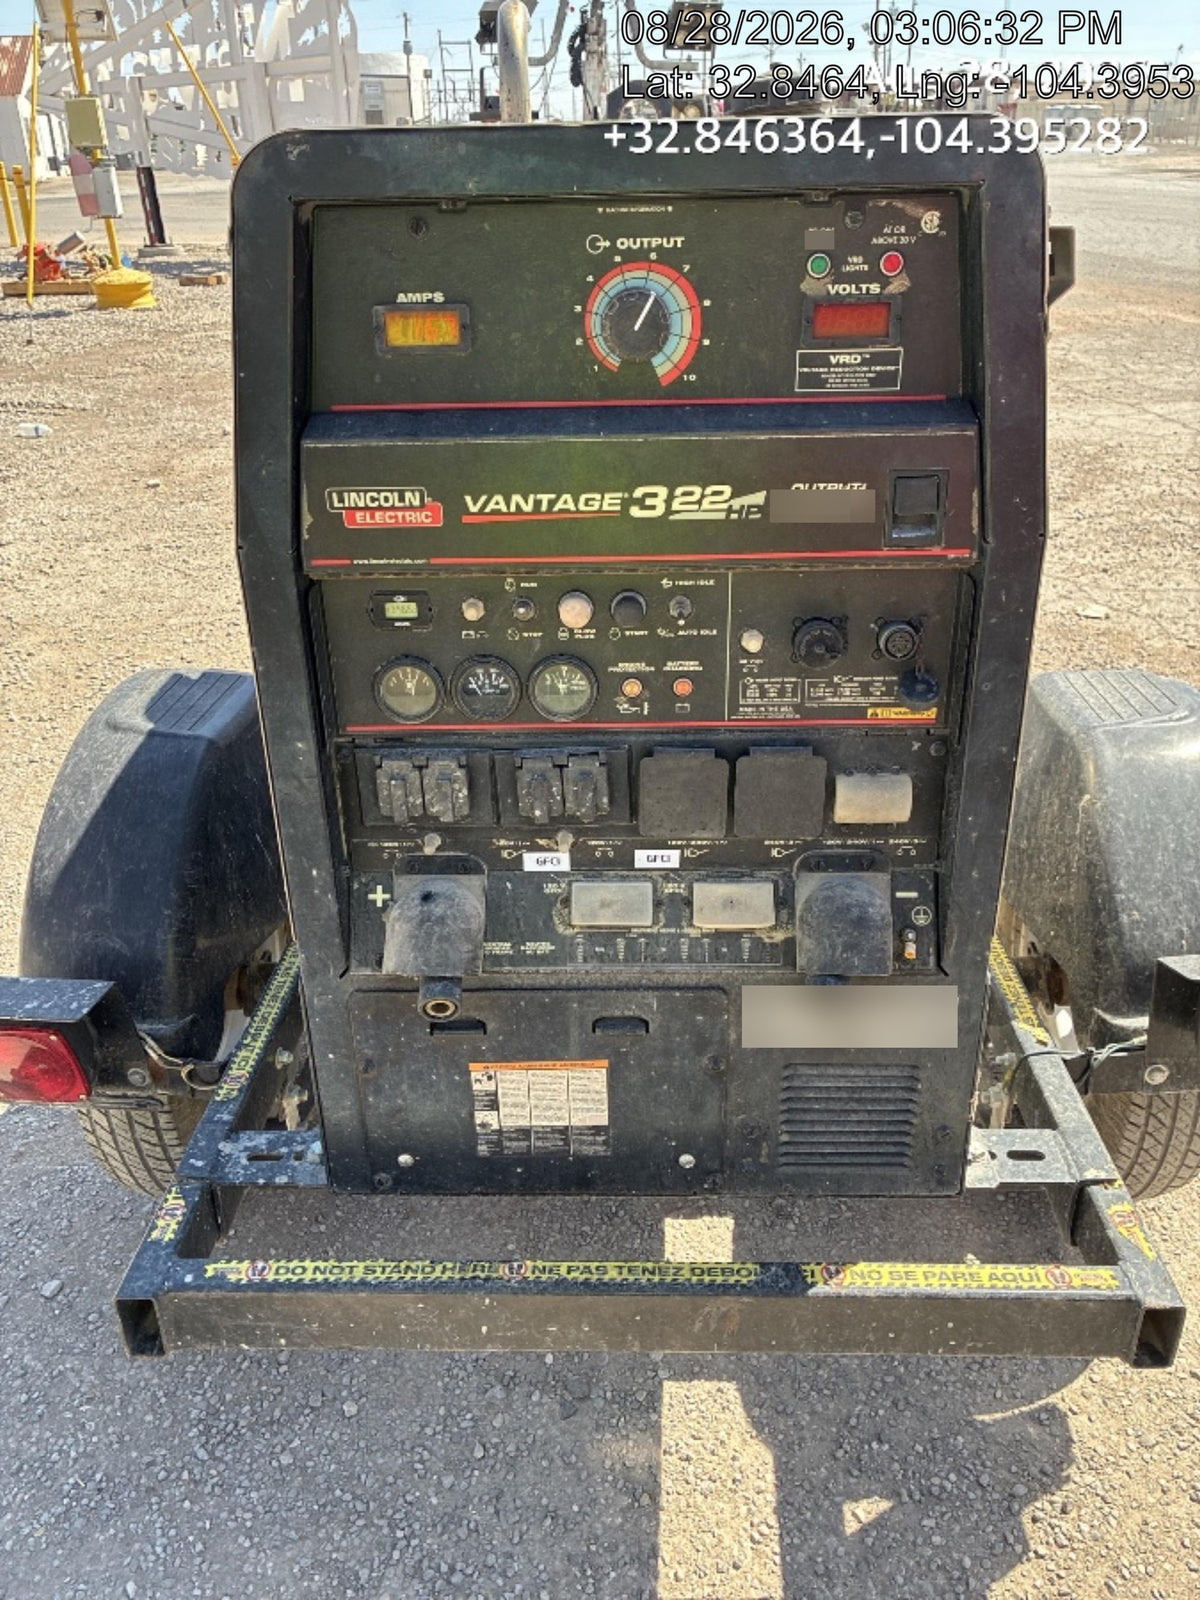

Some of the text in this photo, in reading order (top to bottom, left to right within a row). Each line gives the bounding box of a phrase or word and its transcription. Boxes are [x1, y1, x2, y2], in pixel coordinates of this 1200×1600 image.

[616, 237, 685, 250] OUTPUT
[683, 265, 691, 273] 7
[842, 264, 869, 273] LIGHTS
[827, 283, 881, 295] VOLTS
[396, 291, 445, 304] AMPS
[575, 338, 583, 346] 2
[593, 365, 599, 373] 1
[682, 374, 697, 382] 10
[332, 491, 421, 508] LINCOLN
[628, 484, 732, 519] 322
[355, 511, 433, 524] ELECTRIC
[536, 856, 561, 867] GFCI
[646, 853, 671, 864] GFCI
[274, 1265, 309, 1276] DO
[311, 1264, 358, 1276] NOT
[362, 1264, 436, 1276] STAND
[531, 1265, 561, 1276] NE
[566, 1265, 608, 1277] PAS
[612, 1265, 686, 1277] TENEZ
[850, 1269, 882, 1281] NO
[888, 1270, 918, 1281] SE
[922, 1270, 984, 1282] PARE
